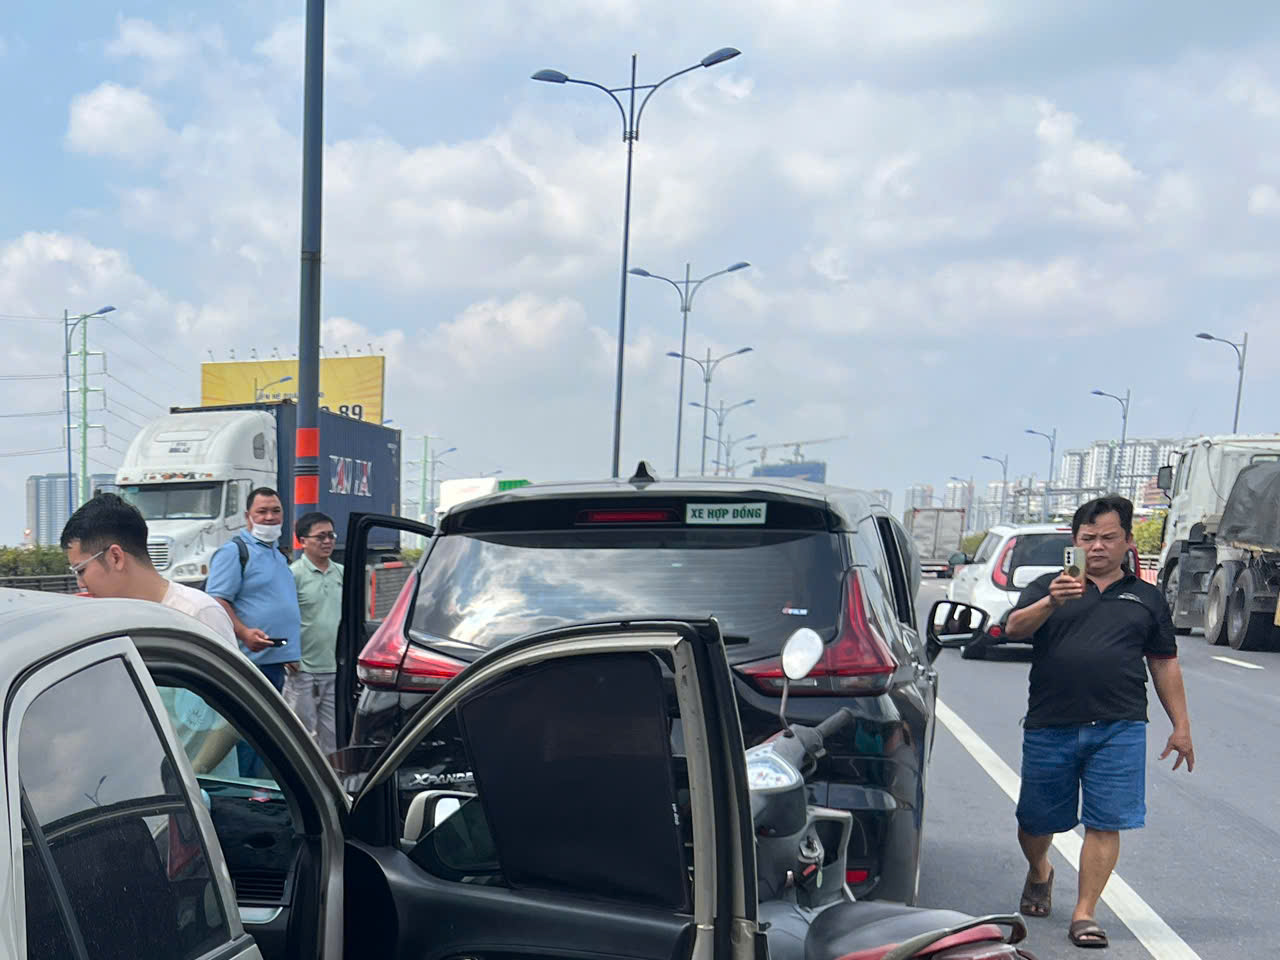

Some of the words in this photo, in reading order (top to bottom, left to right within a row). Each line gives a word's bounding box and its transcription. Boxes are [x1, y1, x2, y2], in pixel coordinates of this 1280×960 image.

[691, 508, 704, 519] XE
[707, 507, 729, 522] HỢP
[409, 771, 475, 786] XPANDE
